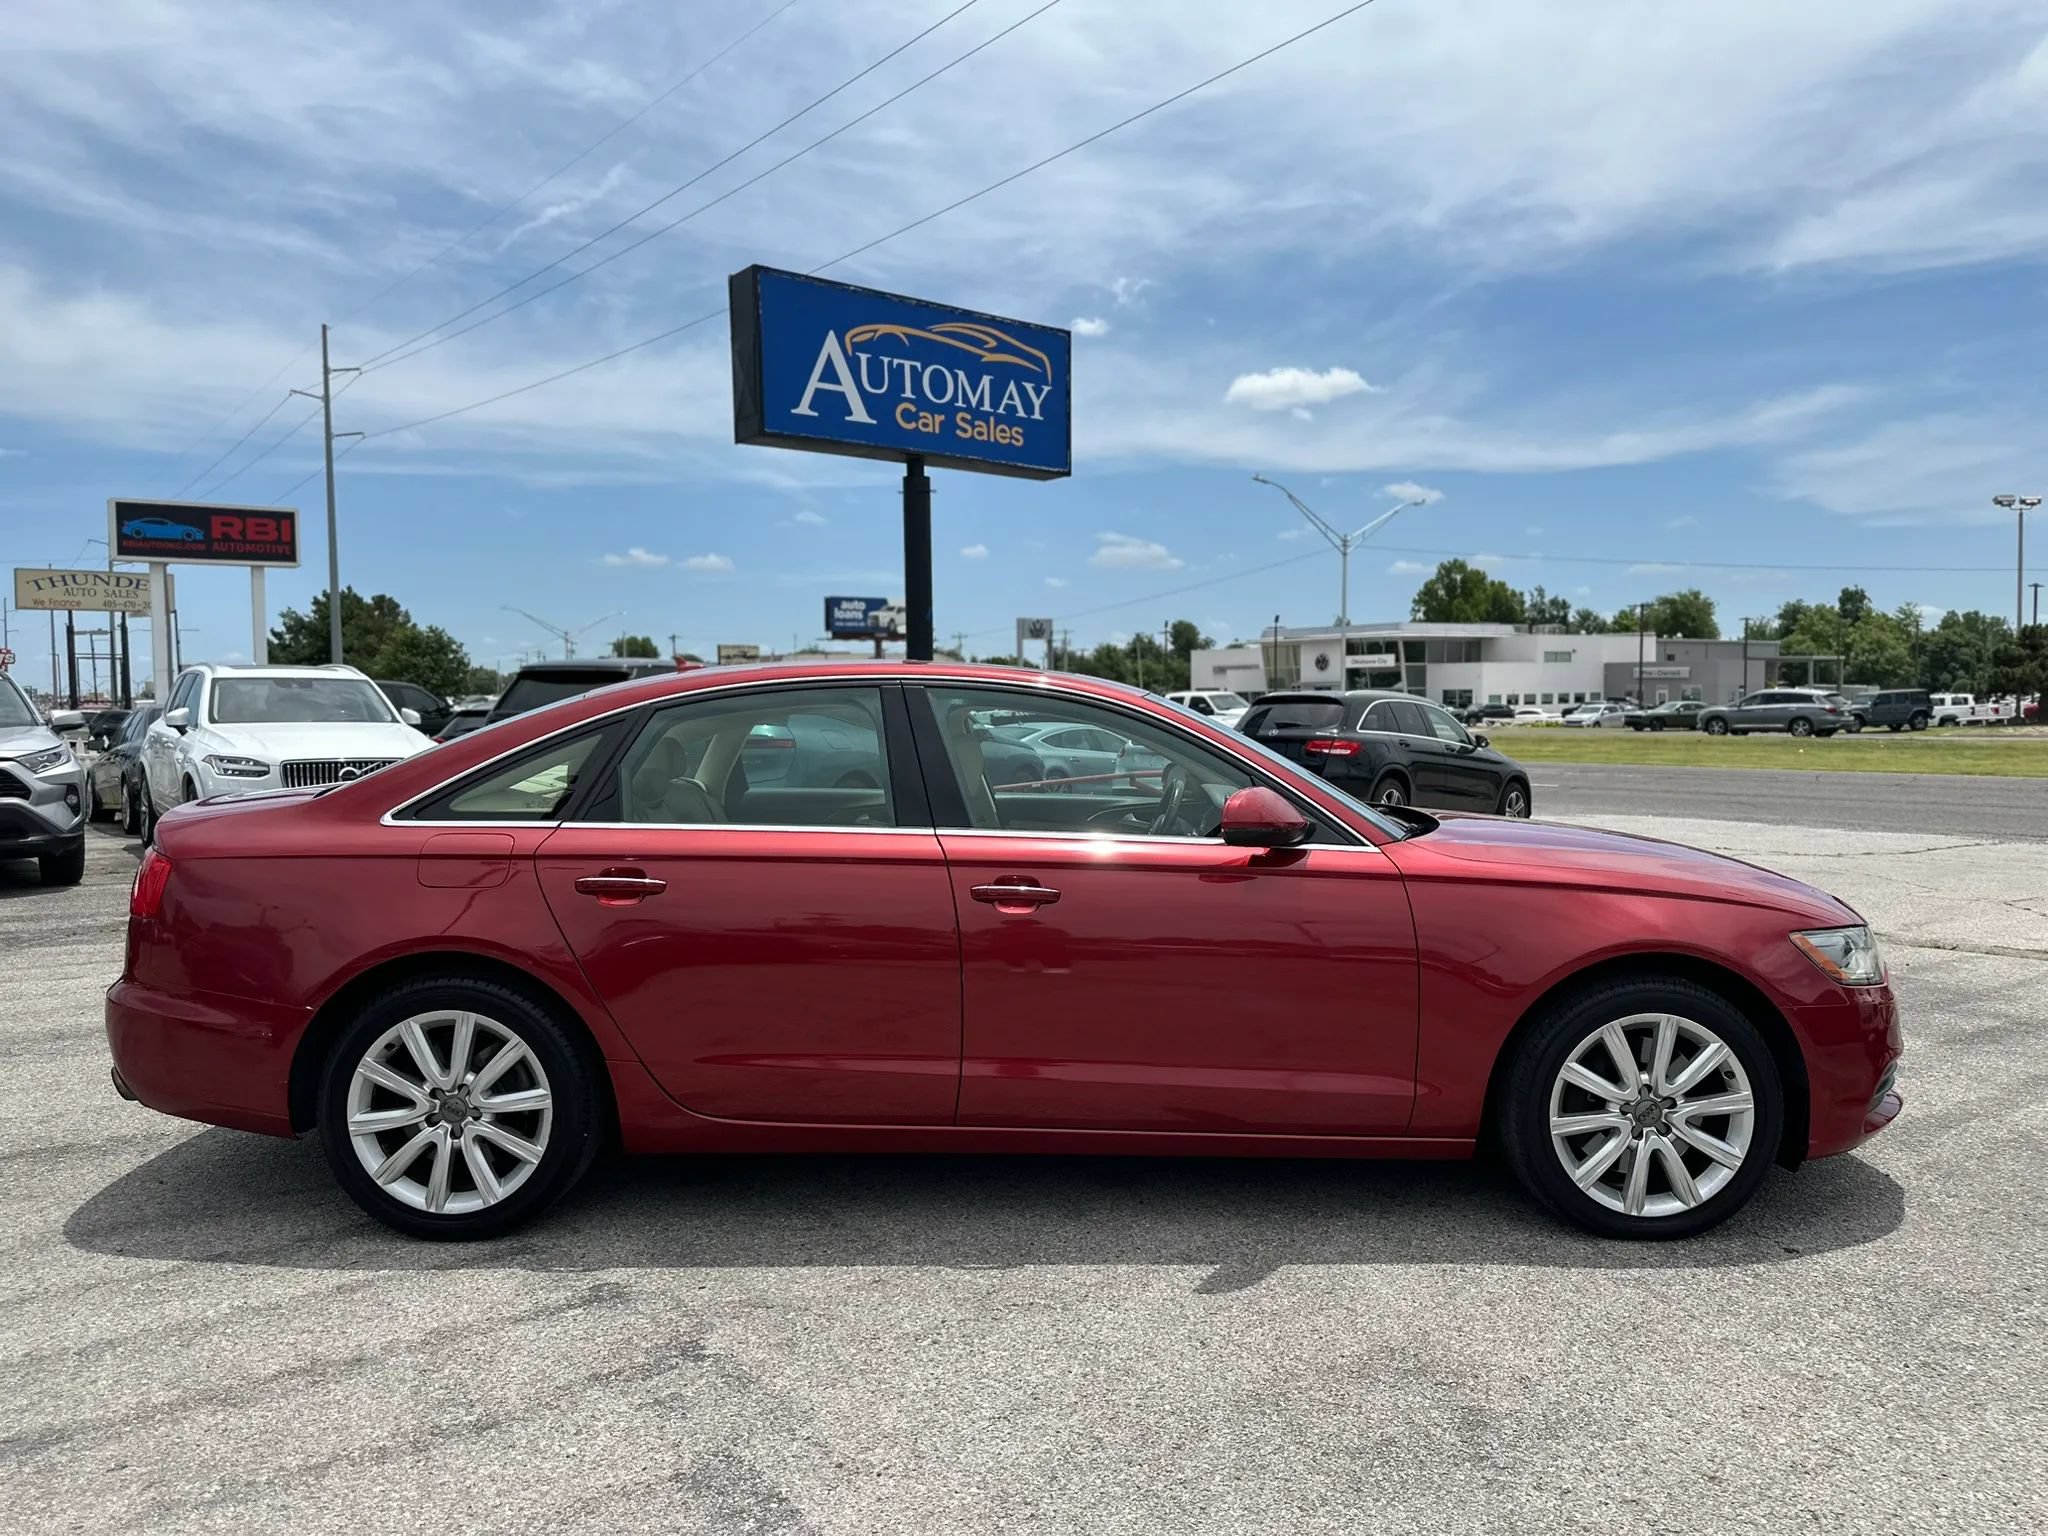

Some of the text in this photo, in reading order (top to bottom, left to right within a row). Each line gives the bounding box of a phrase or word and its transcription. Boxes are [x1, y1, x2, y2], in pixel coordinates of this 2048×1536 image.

[790, 329, 1052, 424] AUTOMAY
[895, 403, 1024, 447] Car Sales
[210, 515, 292, 542] RBI
[212, 542, 291, 555] AUTOMOTIVE
[63, 587, 139, 599] AUTO SALES
[32, 598, 82, 608] We Finance
[840, 600, 866, 610] auto
[833, 606, 864, 620] loans
